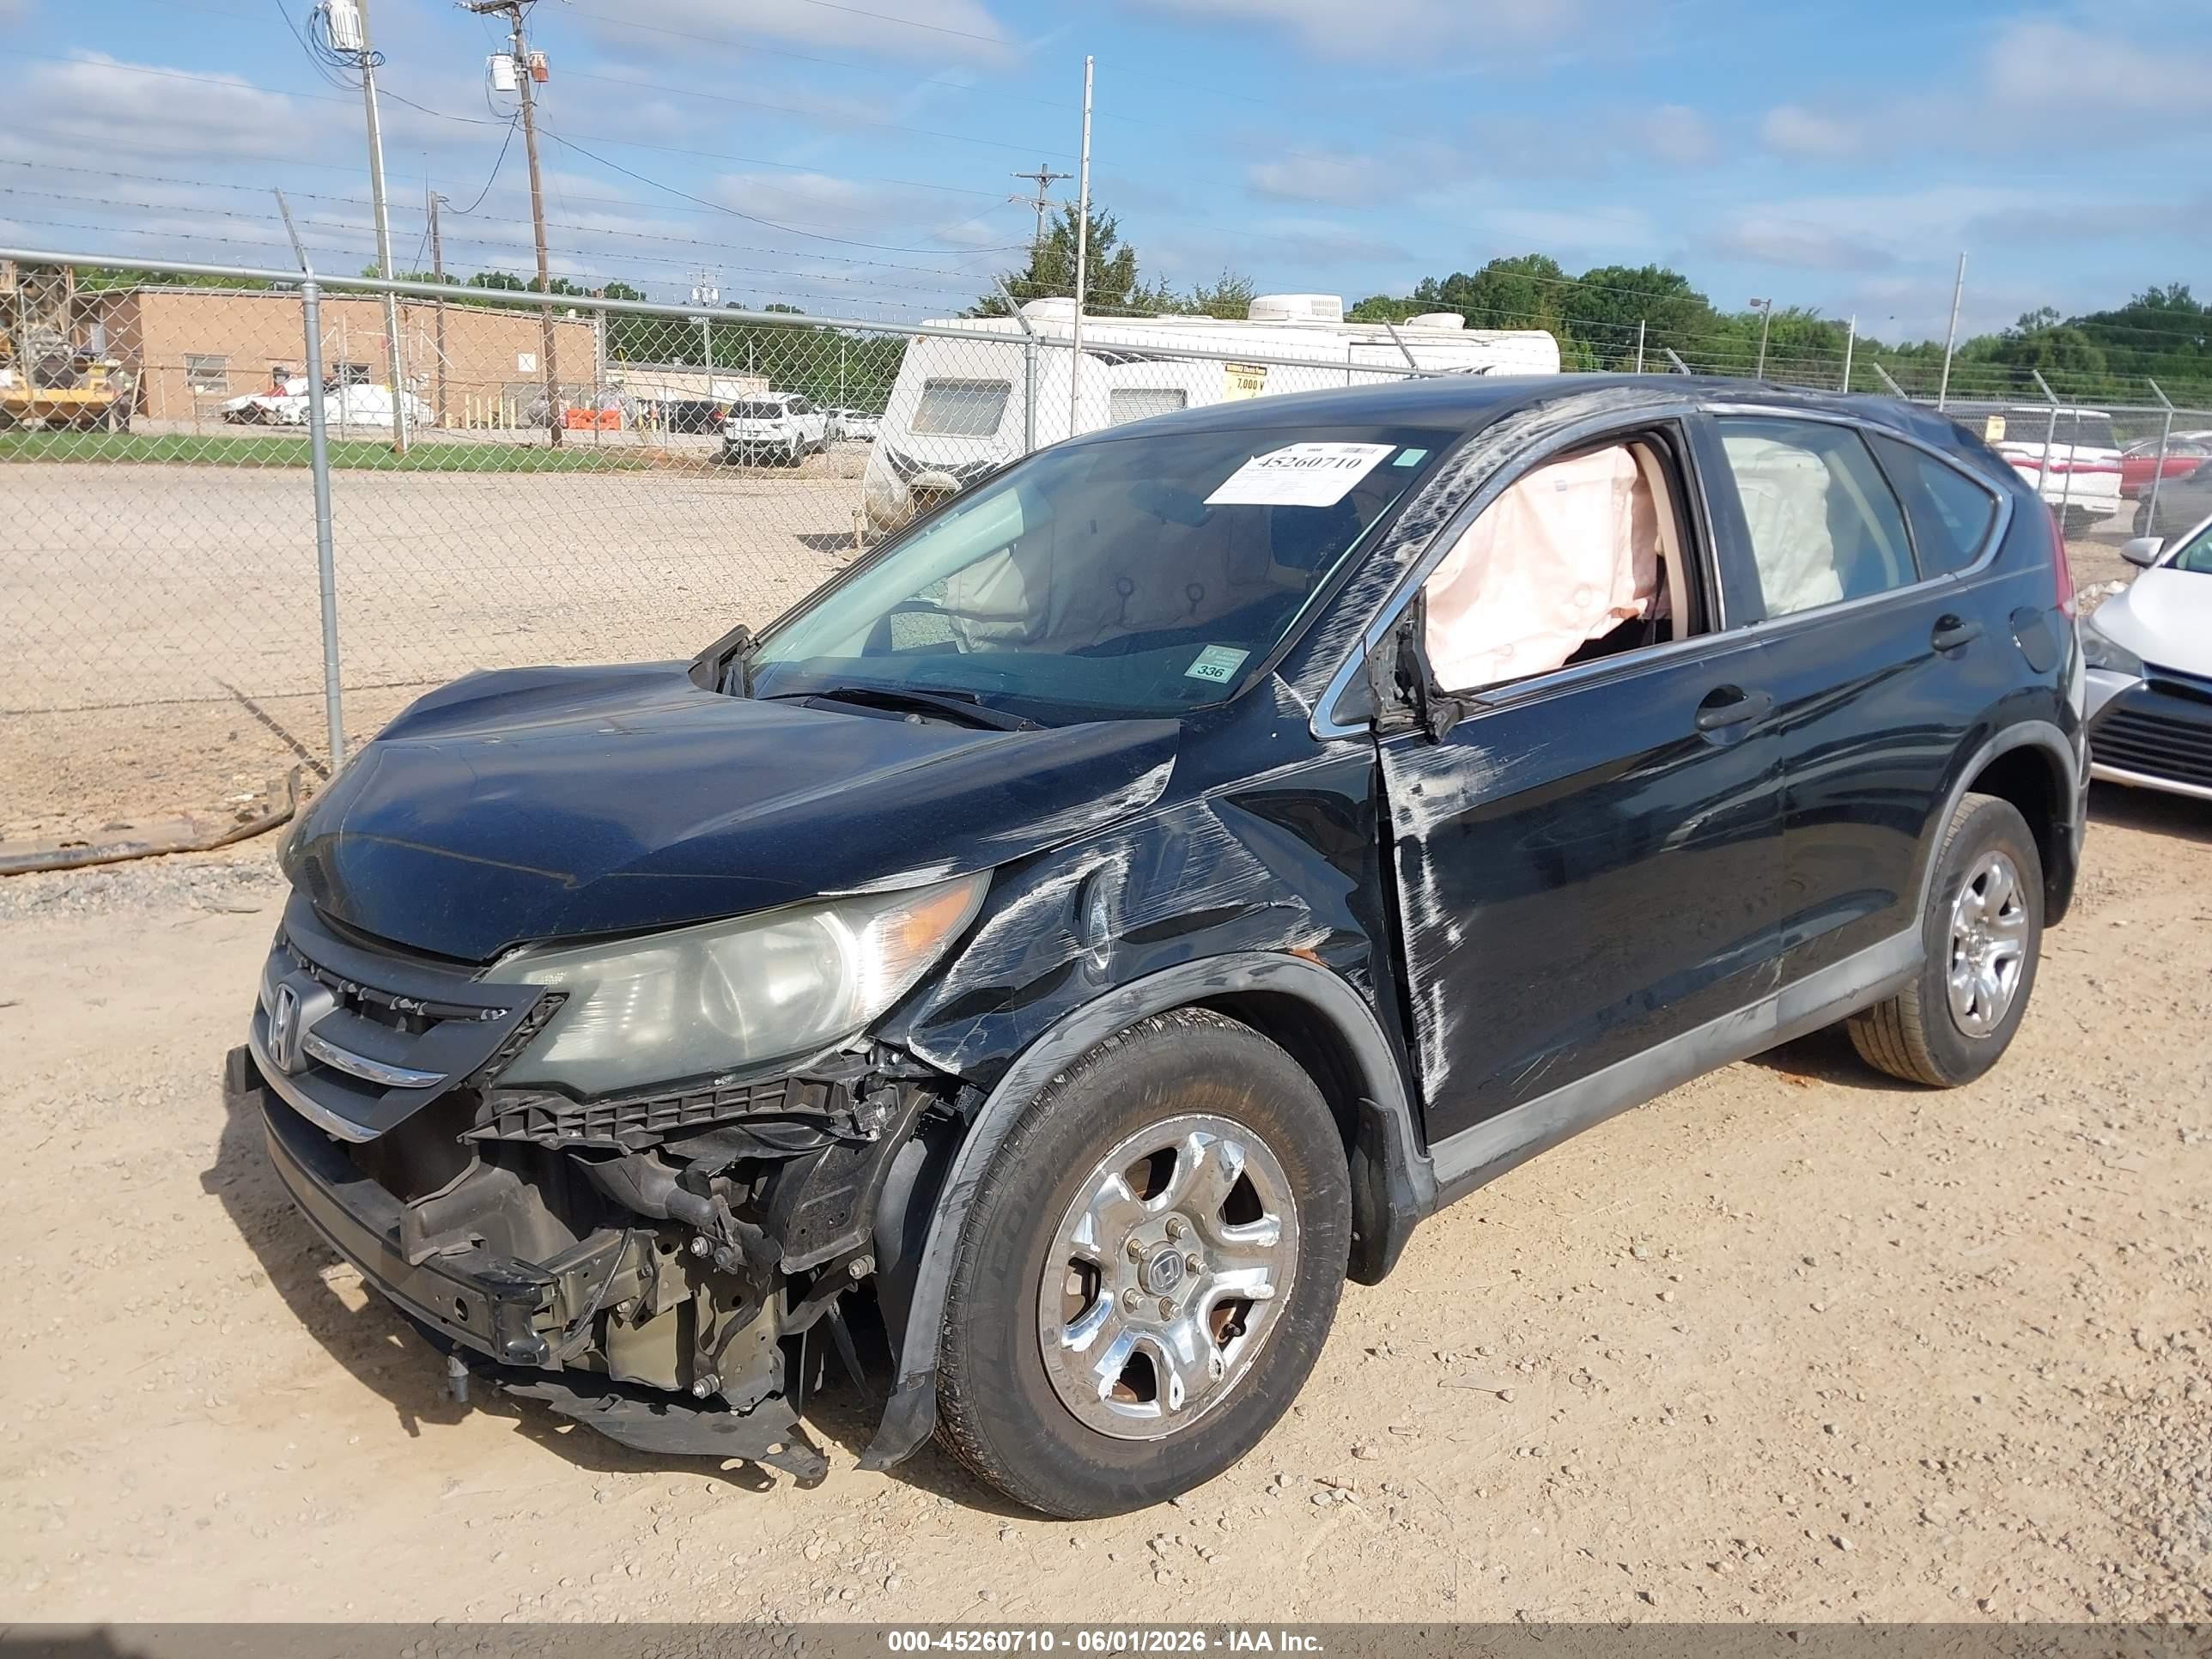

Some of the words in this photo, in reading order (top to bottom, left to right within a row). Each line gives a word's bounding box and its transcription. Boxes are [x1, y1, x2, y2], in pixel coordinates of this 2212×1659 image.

[1237, 378, 1258, 390] 7,000
[1257, 456, 1363, 469] 45260710
[1197, 665, 1224, 678] 336
